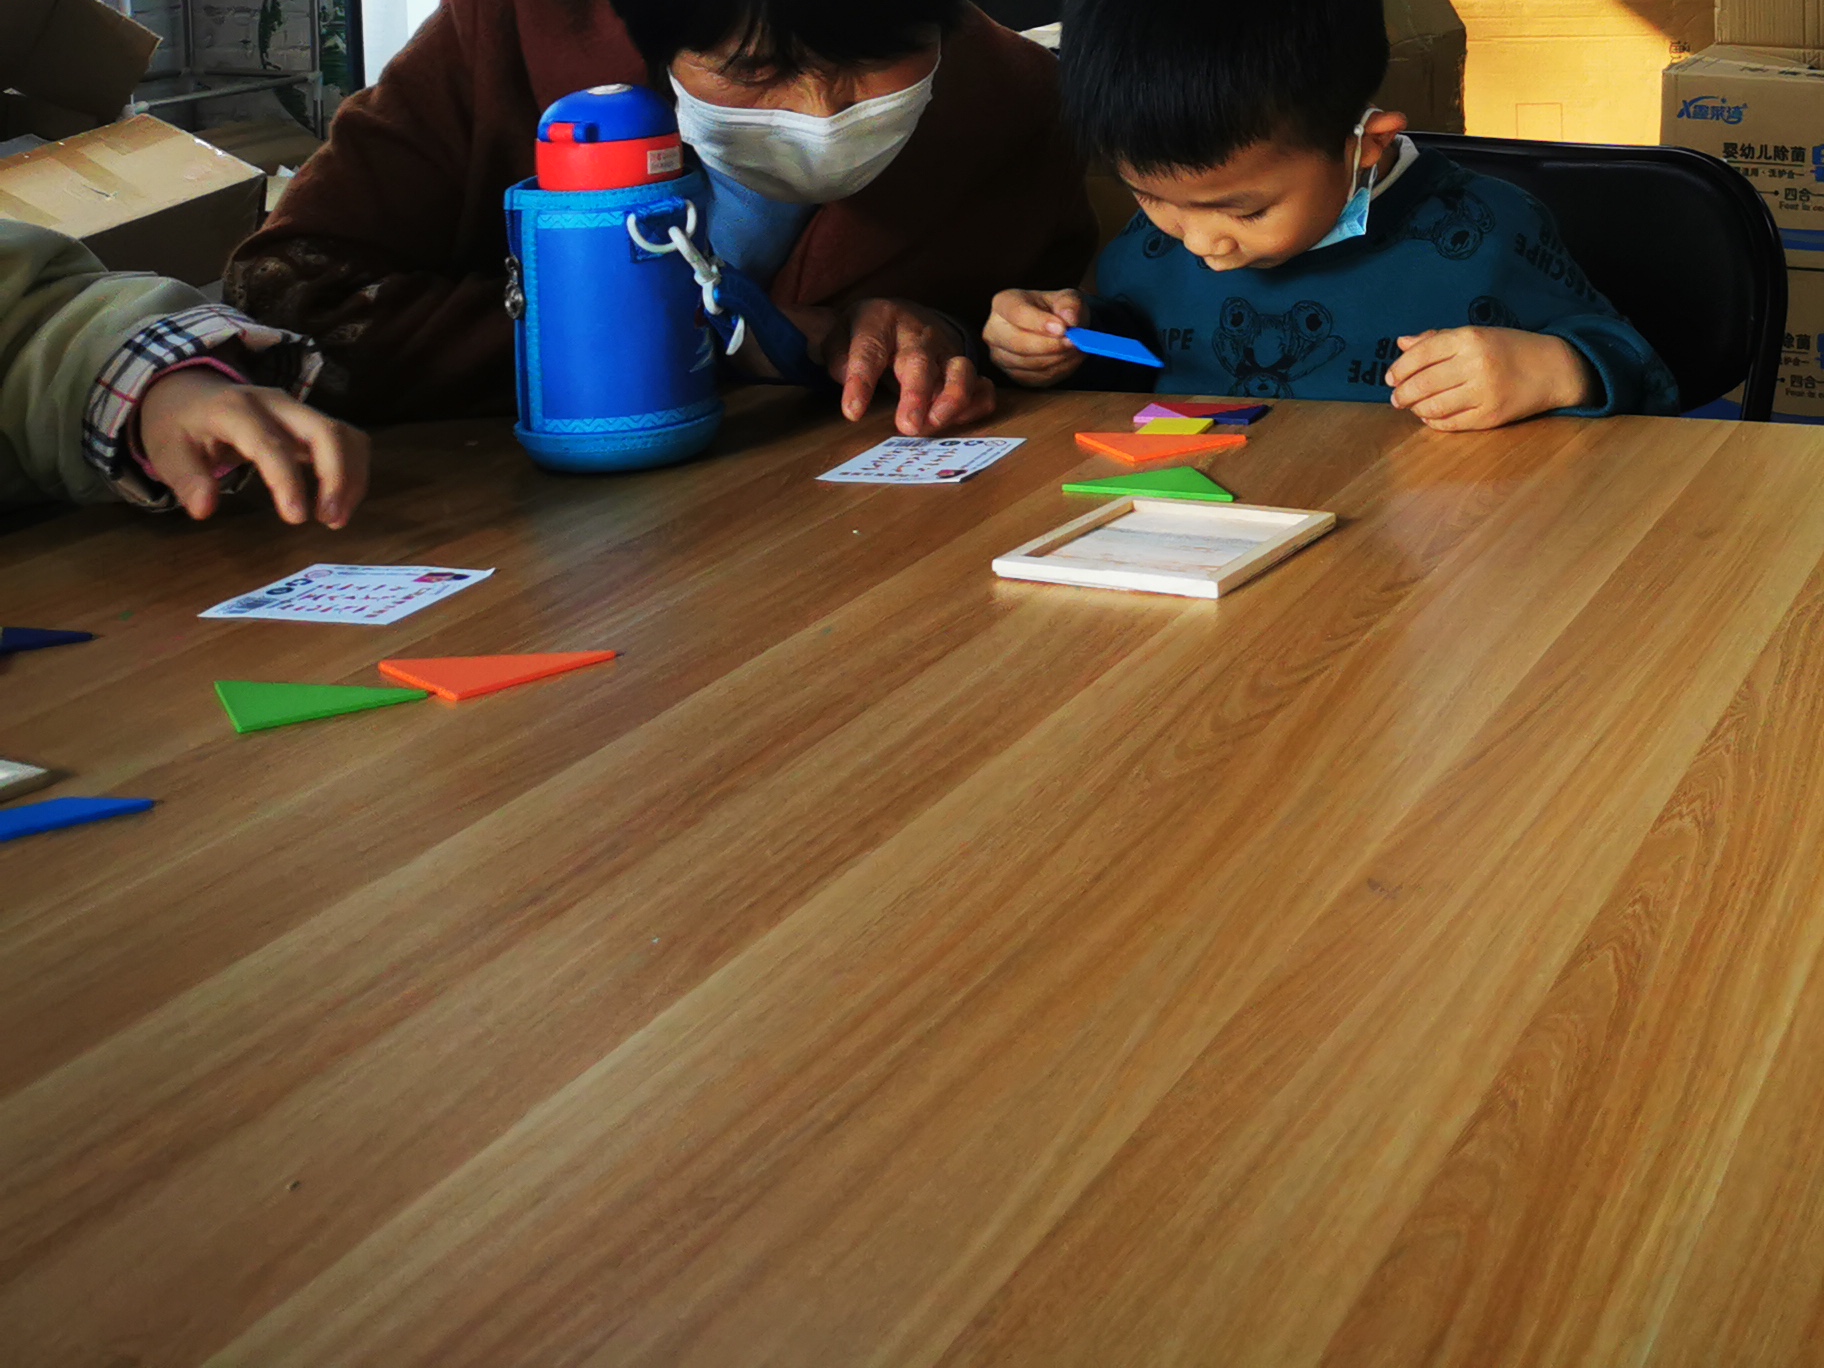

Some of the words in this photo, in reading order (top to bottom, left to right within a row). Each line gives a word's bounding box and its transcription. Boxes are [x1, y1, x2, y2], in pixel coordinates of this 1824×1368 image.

[1722, 142, 1807, 164] 婴幼儿除菌
